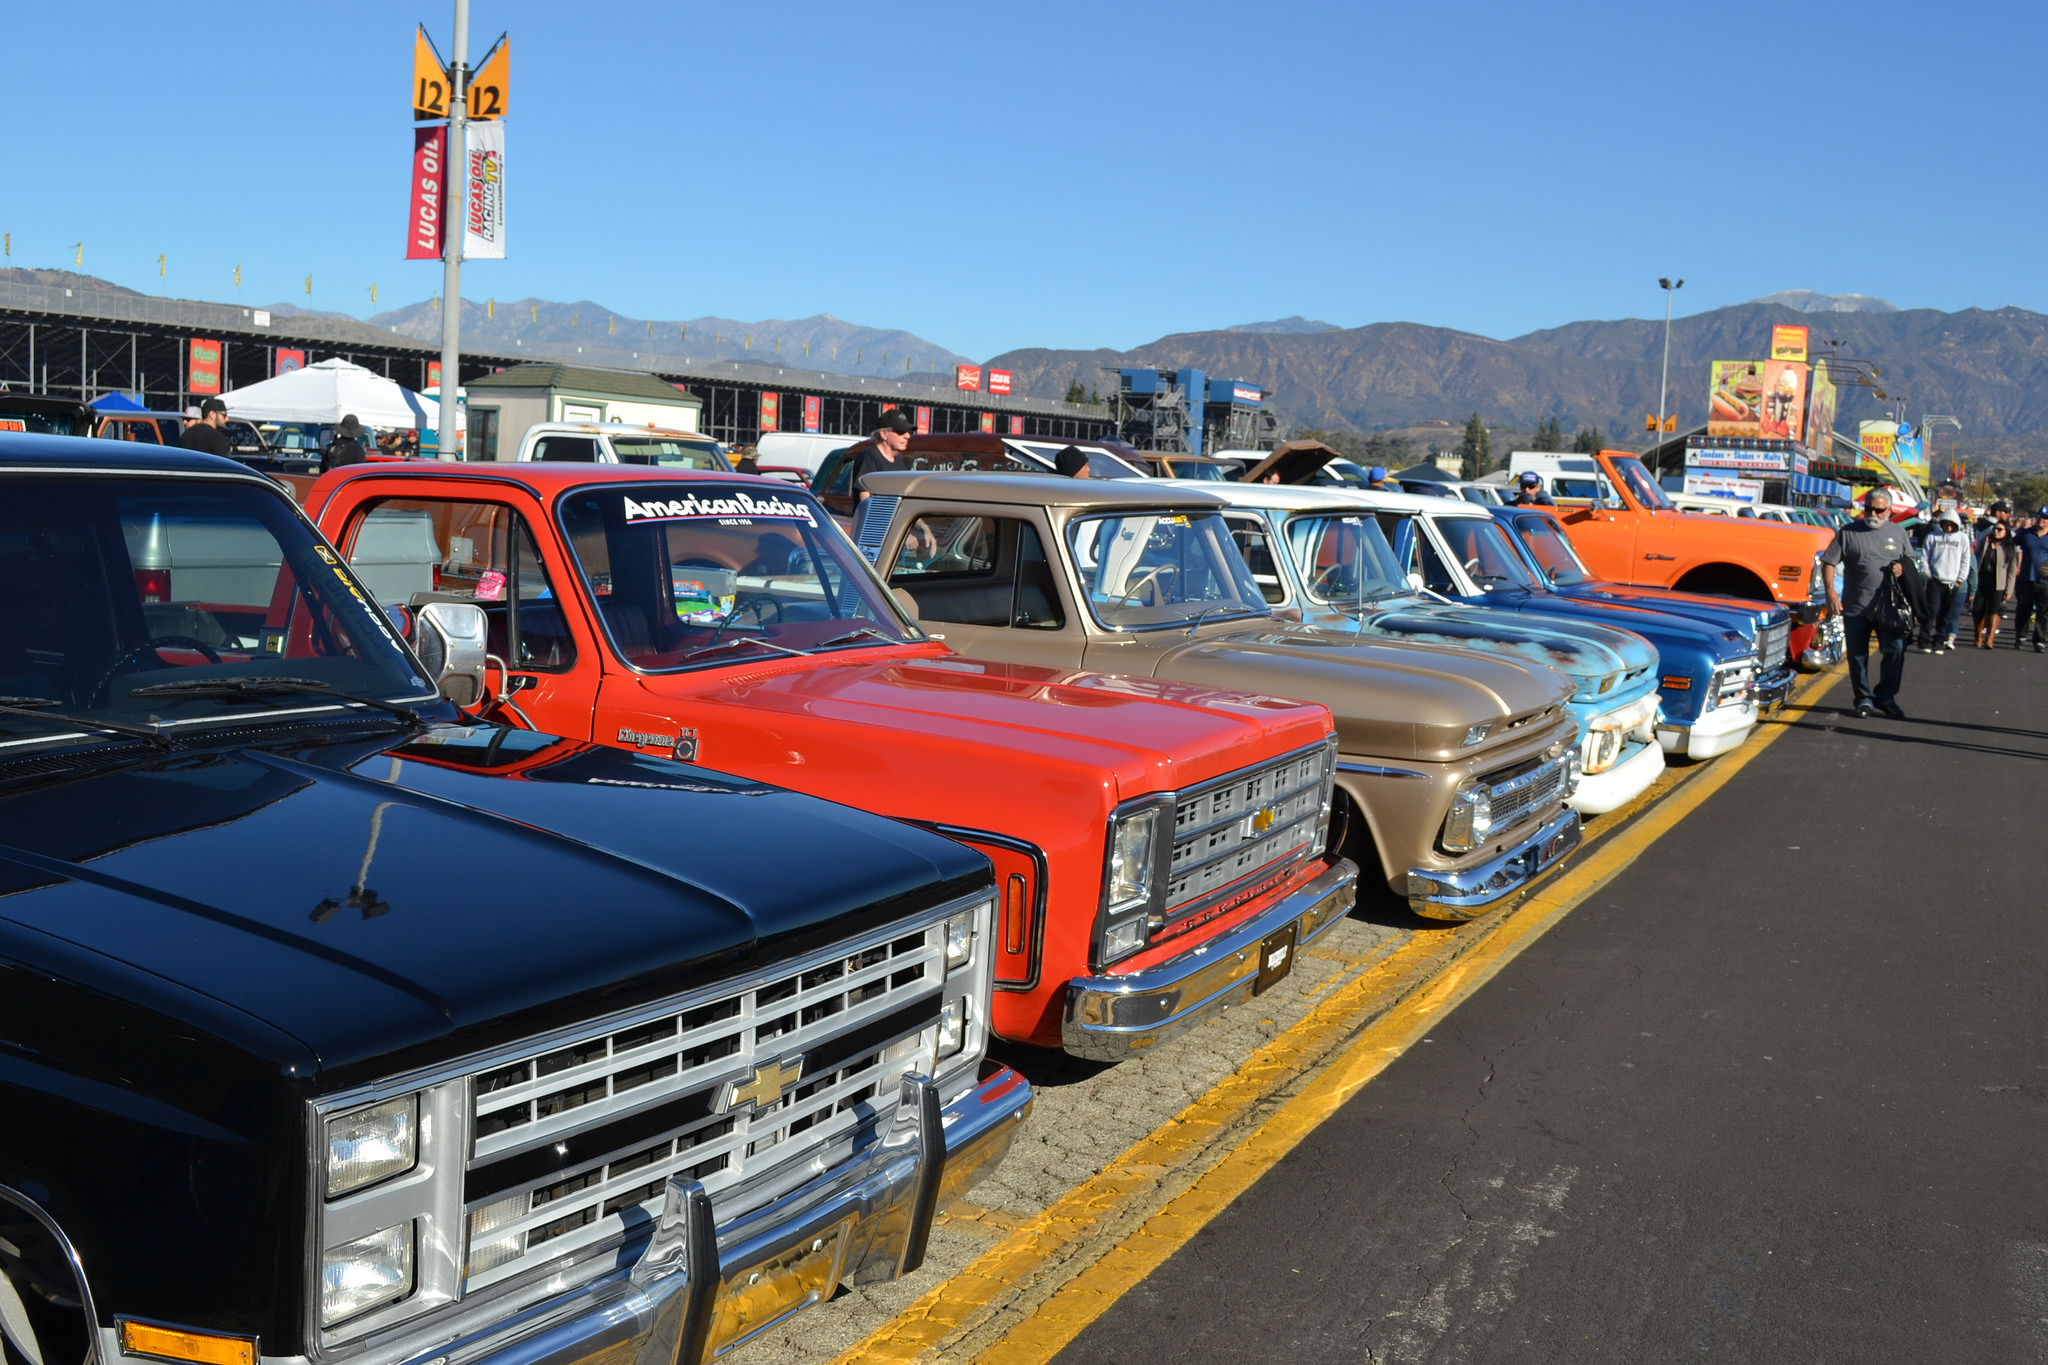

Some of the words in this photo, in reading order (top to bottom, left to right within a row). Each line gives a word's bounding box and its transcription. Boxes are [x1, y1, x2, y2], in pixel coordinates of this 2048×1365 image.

[419, 78, 443, 112] 12
[473, 86, 501, 115] 12
[422, 139, 439, 174] OIL
[471, 152, 483, 178] OIL
[485, 157, 498, 184] TV
[418, 177, 439, 250] LUCAS
[469, 180, 483, 234] LUCAS
[482, 182, 494, 242] RACING
[1866, 445, 1884, 453] BEER
[617, 728, 677, 748] Cheyenne
